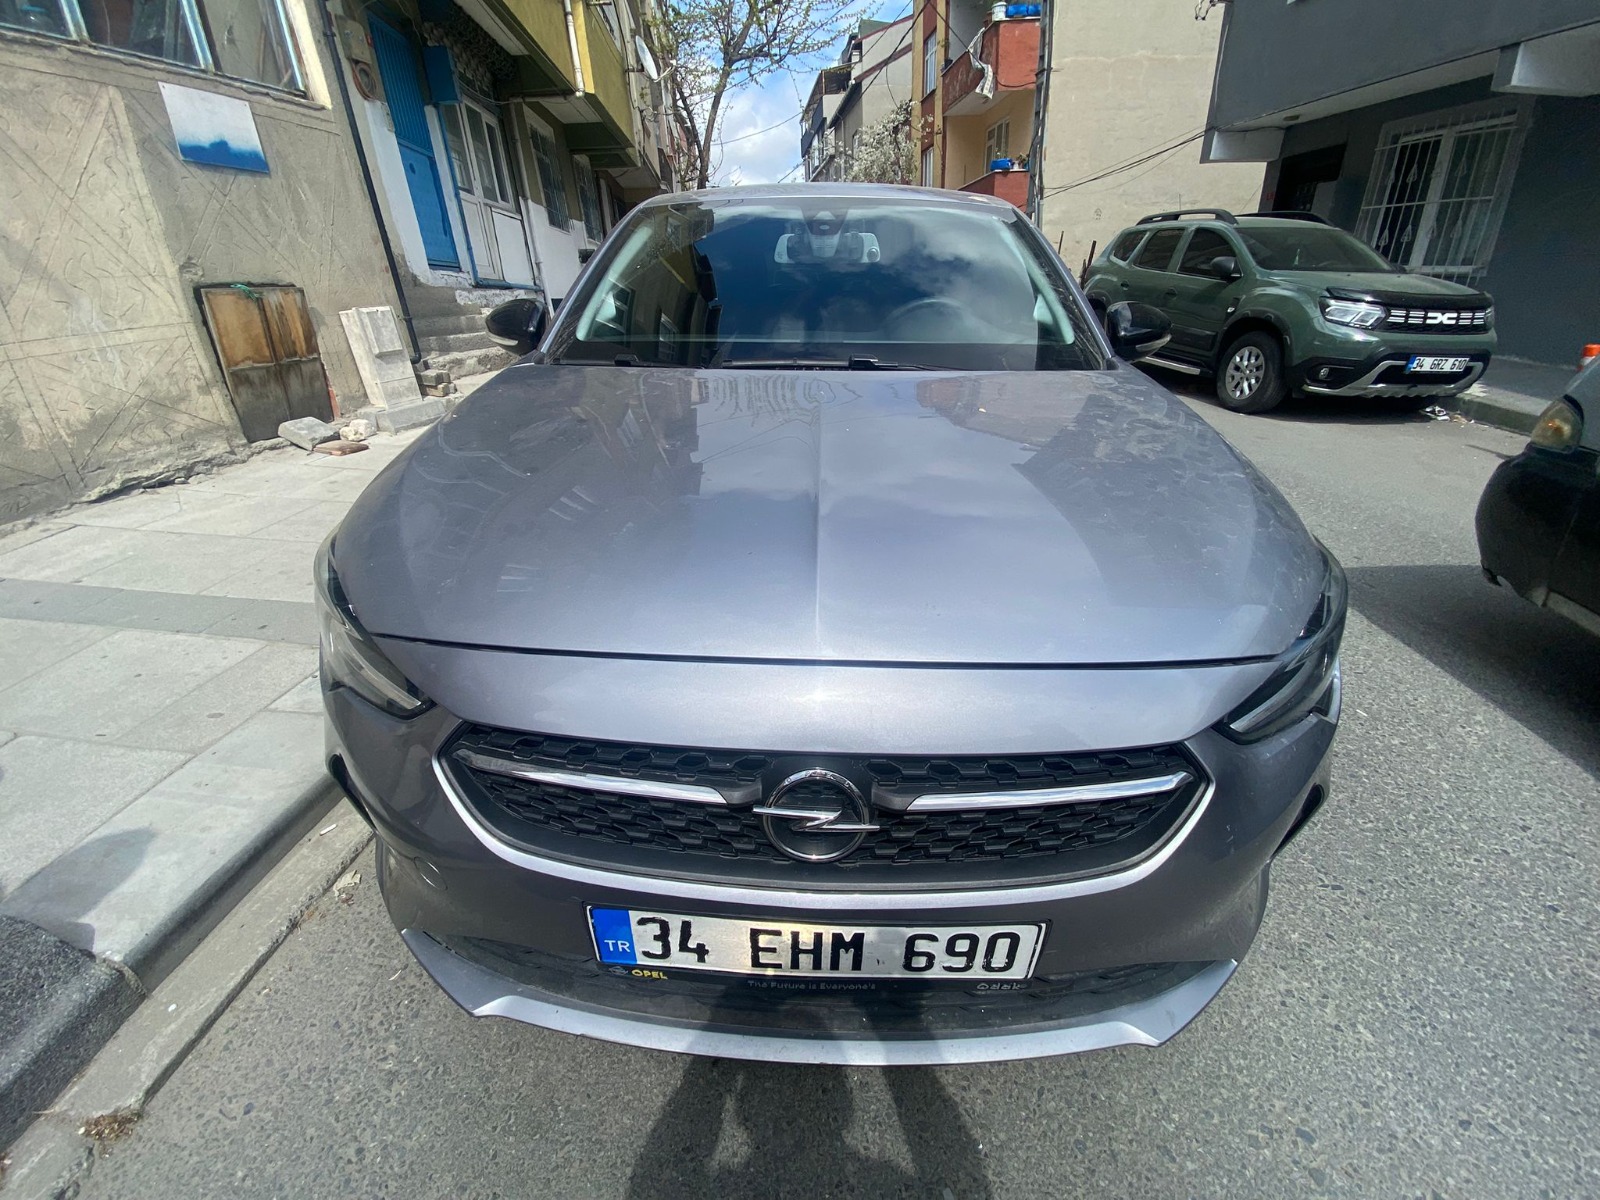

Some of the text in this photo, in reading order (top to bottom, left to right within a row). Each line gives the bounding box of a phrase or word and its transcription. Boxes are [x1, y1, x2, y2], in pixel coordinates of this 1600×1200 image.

[1412, 358, 1468, 370] 34 GRZ 610
[604, 939, 631, 953] TR
[636, 916, 1021, 973] 34 EHM 690
[631, 969, 669, 980] OPEL
[747, 980, 876, 991] The Future is Everyone's
